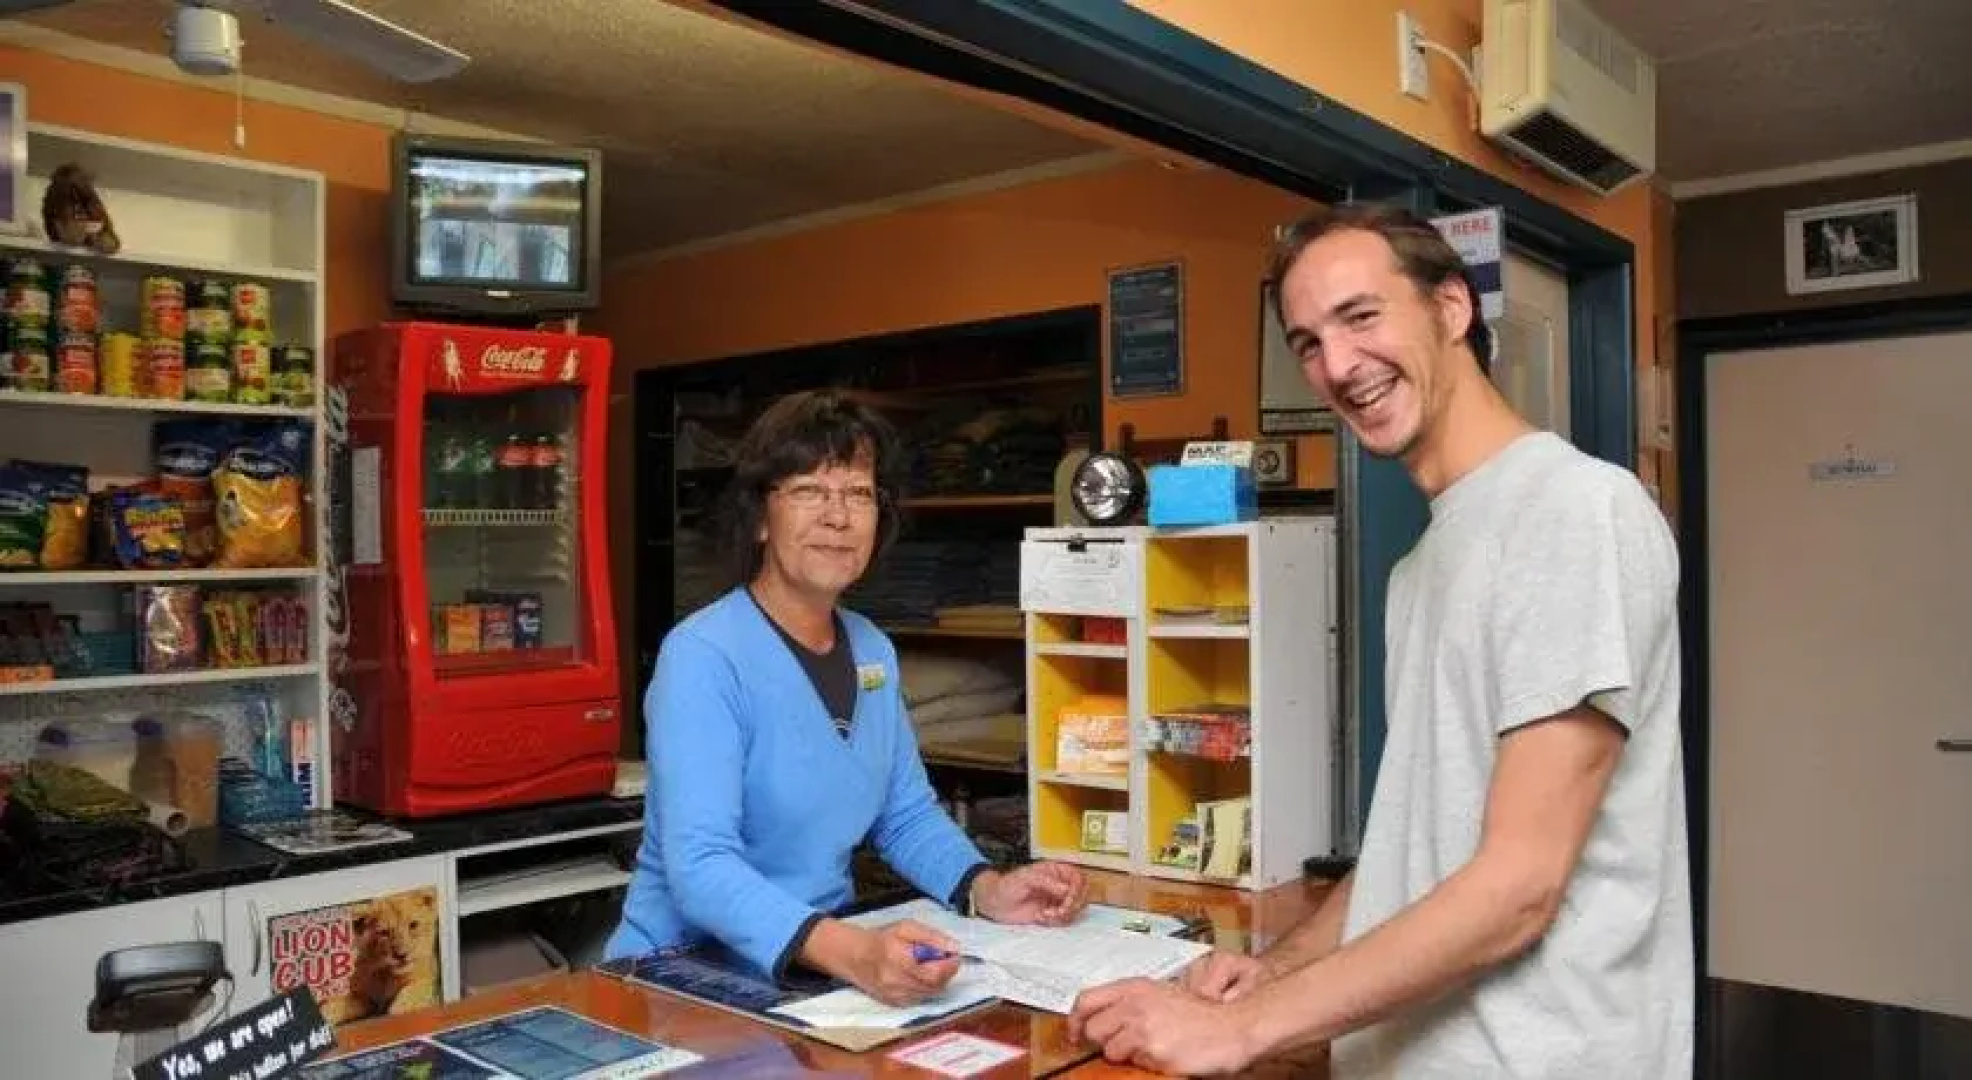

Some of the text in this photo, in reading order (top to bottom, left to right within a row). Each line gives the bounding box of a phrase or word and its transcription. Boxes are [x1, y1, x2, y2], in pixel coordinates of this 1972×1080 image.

[273, 921, 351, 959] LION
[274, 951, 352, 990] CUB
[230, 1024, 255, 1050] are
[257, 997, 294, 1039] open!
